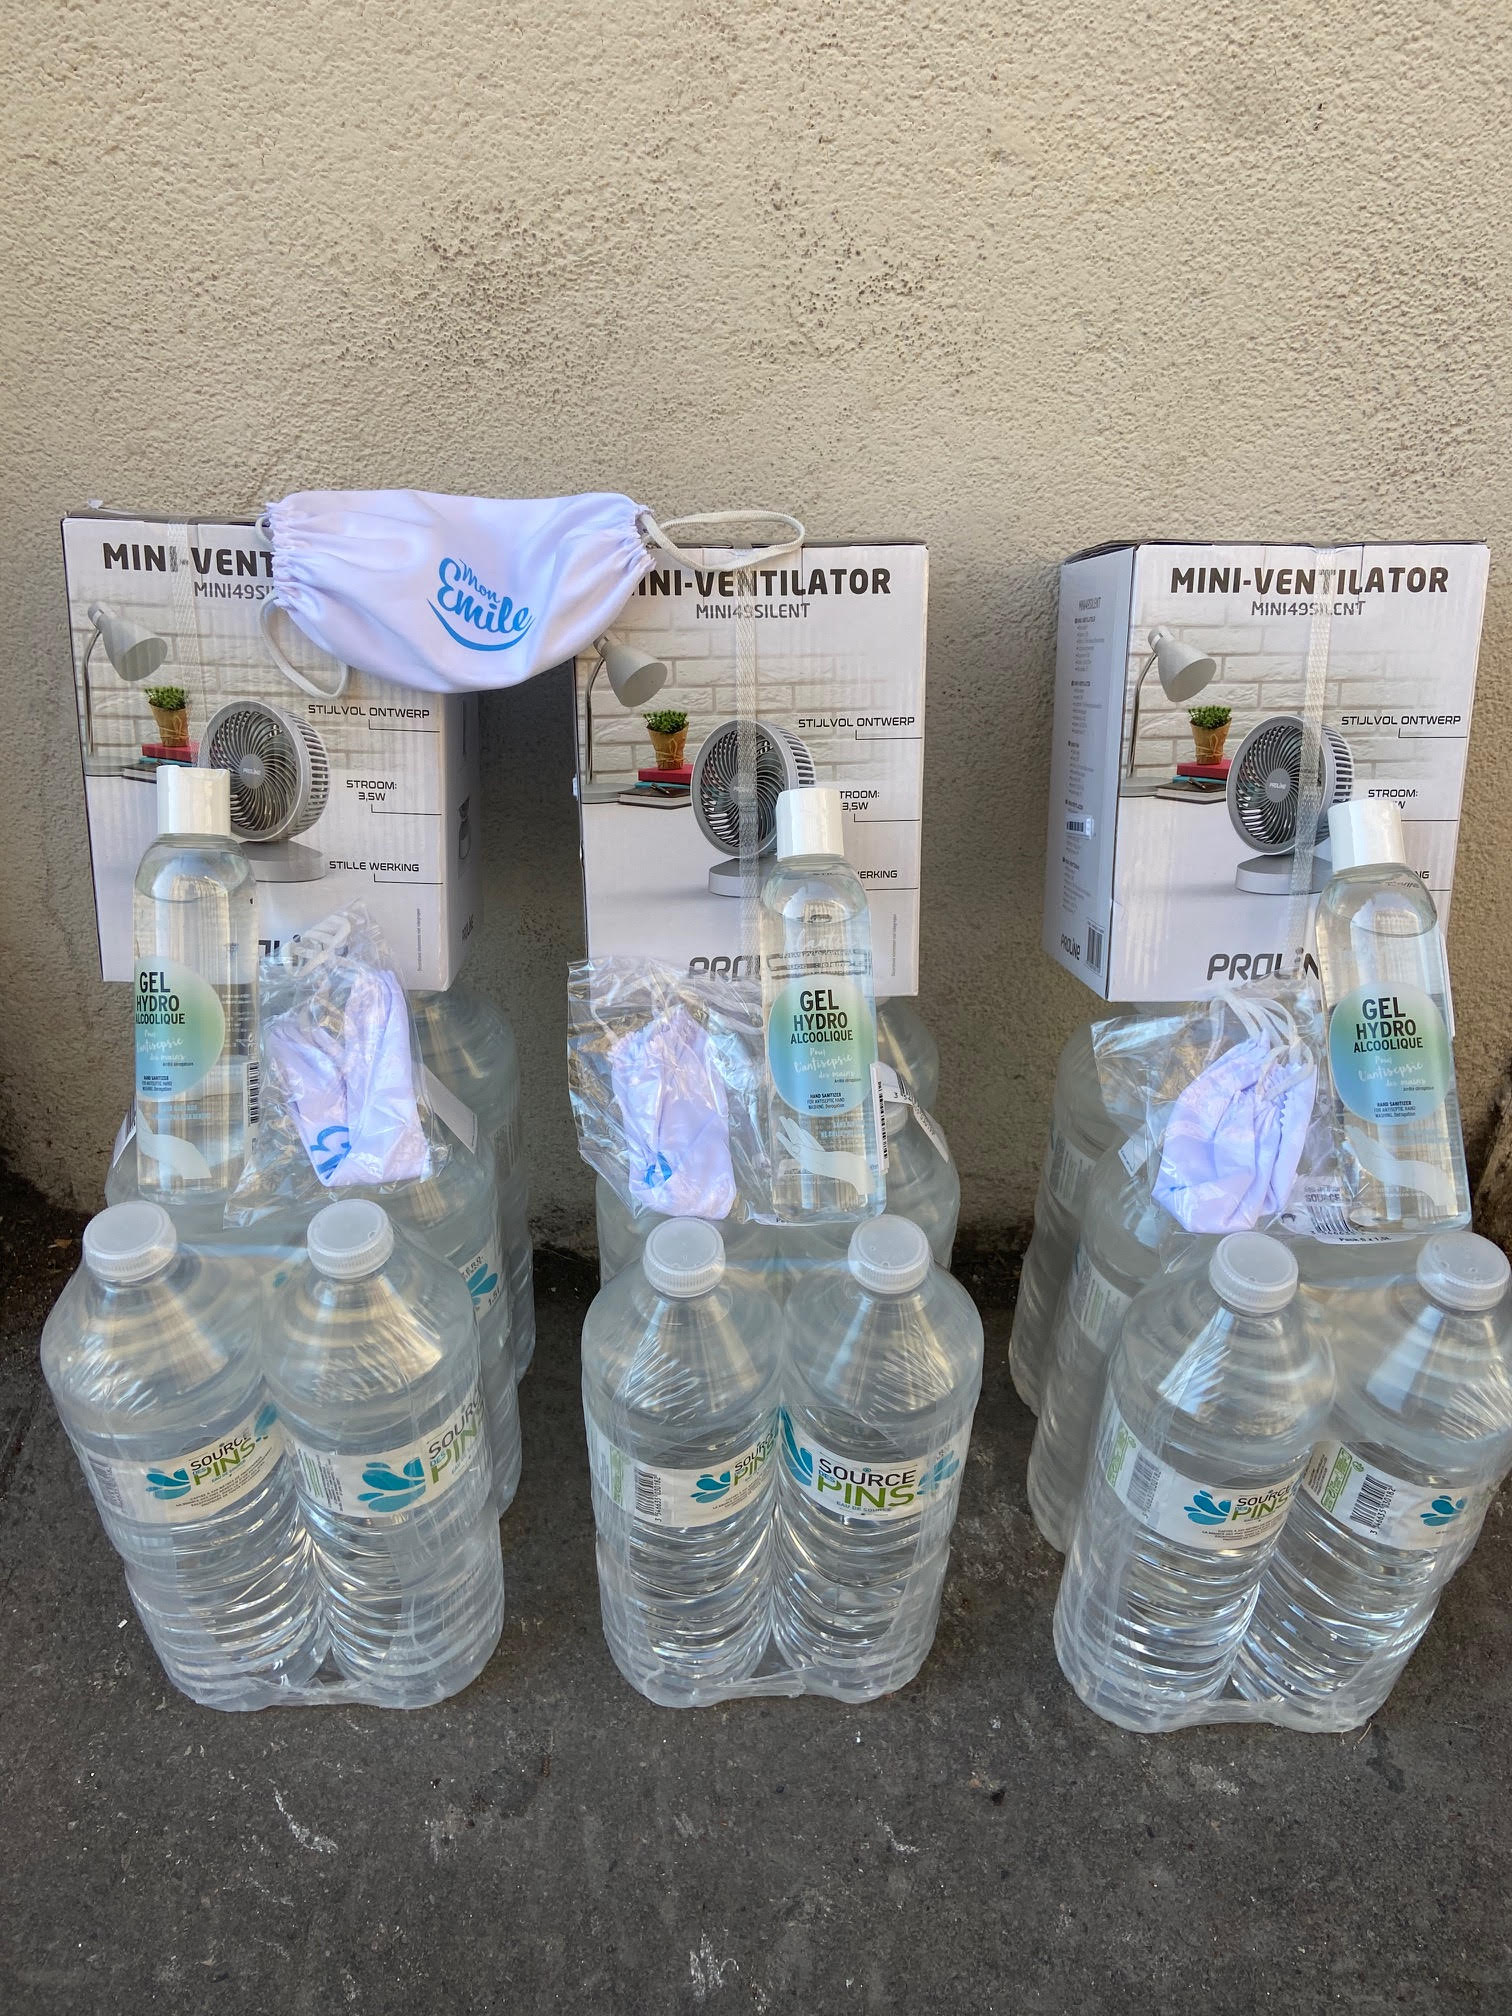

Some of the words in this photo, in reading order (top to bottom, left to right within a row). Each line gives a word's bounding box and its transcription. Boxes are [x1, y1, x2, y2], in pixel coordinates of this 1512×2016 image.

[103, 542, 274, 577] MINI-VENT
[459, 558, 500, 604] Mon
[631, 568, 891, 598] INI-VENTILATOR
[1170, 567, 1449, 595] MINI-VENTILATOR
[437, 557, 533, 634] Emile
[308, 705, 366, 716] STIJLVOL
[369, 707, 430, 719] ONTWERP
[1341, 716, 1398, 725] STIJLVOL
[1401, 715, 1461, 725] ONTWERP
[799, 718, 854, 728] STIJLVOL
[857, 716, 915, 727] ONTWERP
[346, 780, 398, 790] STROOM:
[1368, 789, 1418, 798] STROOM:
[358, 792, 386, 802] 3,5W
[839, 790, 880, 799] TROOM:
[842, 802, 869, 811] 3,5W
[329, 861, 366, 870] STILLE
[369, 862, 420, 872] WERKING
[857, 870, 898, 879] ERKING
[139, 972, 171, 993] GEL
[136, 994, 180, 1012] HYDRO
[800, 989, 839, 1012] GEL
[1362, 997, 1406, 1020] GEL
[135, 1013, 185, 1025] ALCOOLIQUE
[793, 1011, 848, 1032] HYDRO
[790, 1029, 853, 1045] ALCOOLIQUE
[1356, 1019, 1417, 1040] HYDRO
[1353, 1037, 1424, 1053] ALCOOLIQUE
[431, 1412, 478, 1484] PIN
[193, 1438, 256, 1486] PINS
[818, 1469, 836, 1483] DES
[819, 1458, 917, 1487] SOURCE
[817, 1475, 916, 1508] PINS
[836, 1501, 851, 1510] EAU
[1231, 1496, 1288, 1521] PINS
